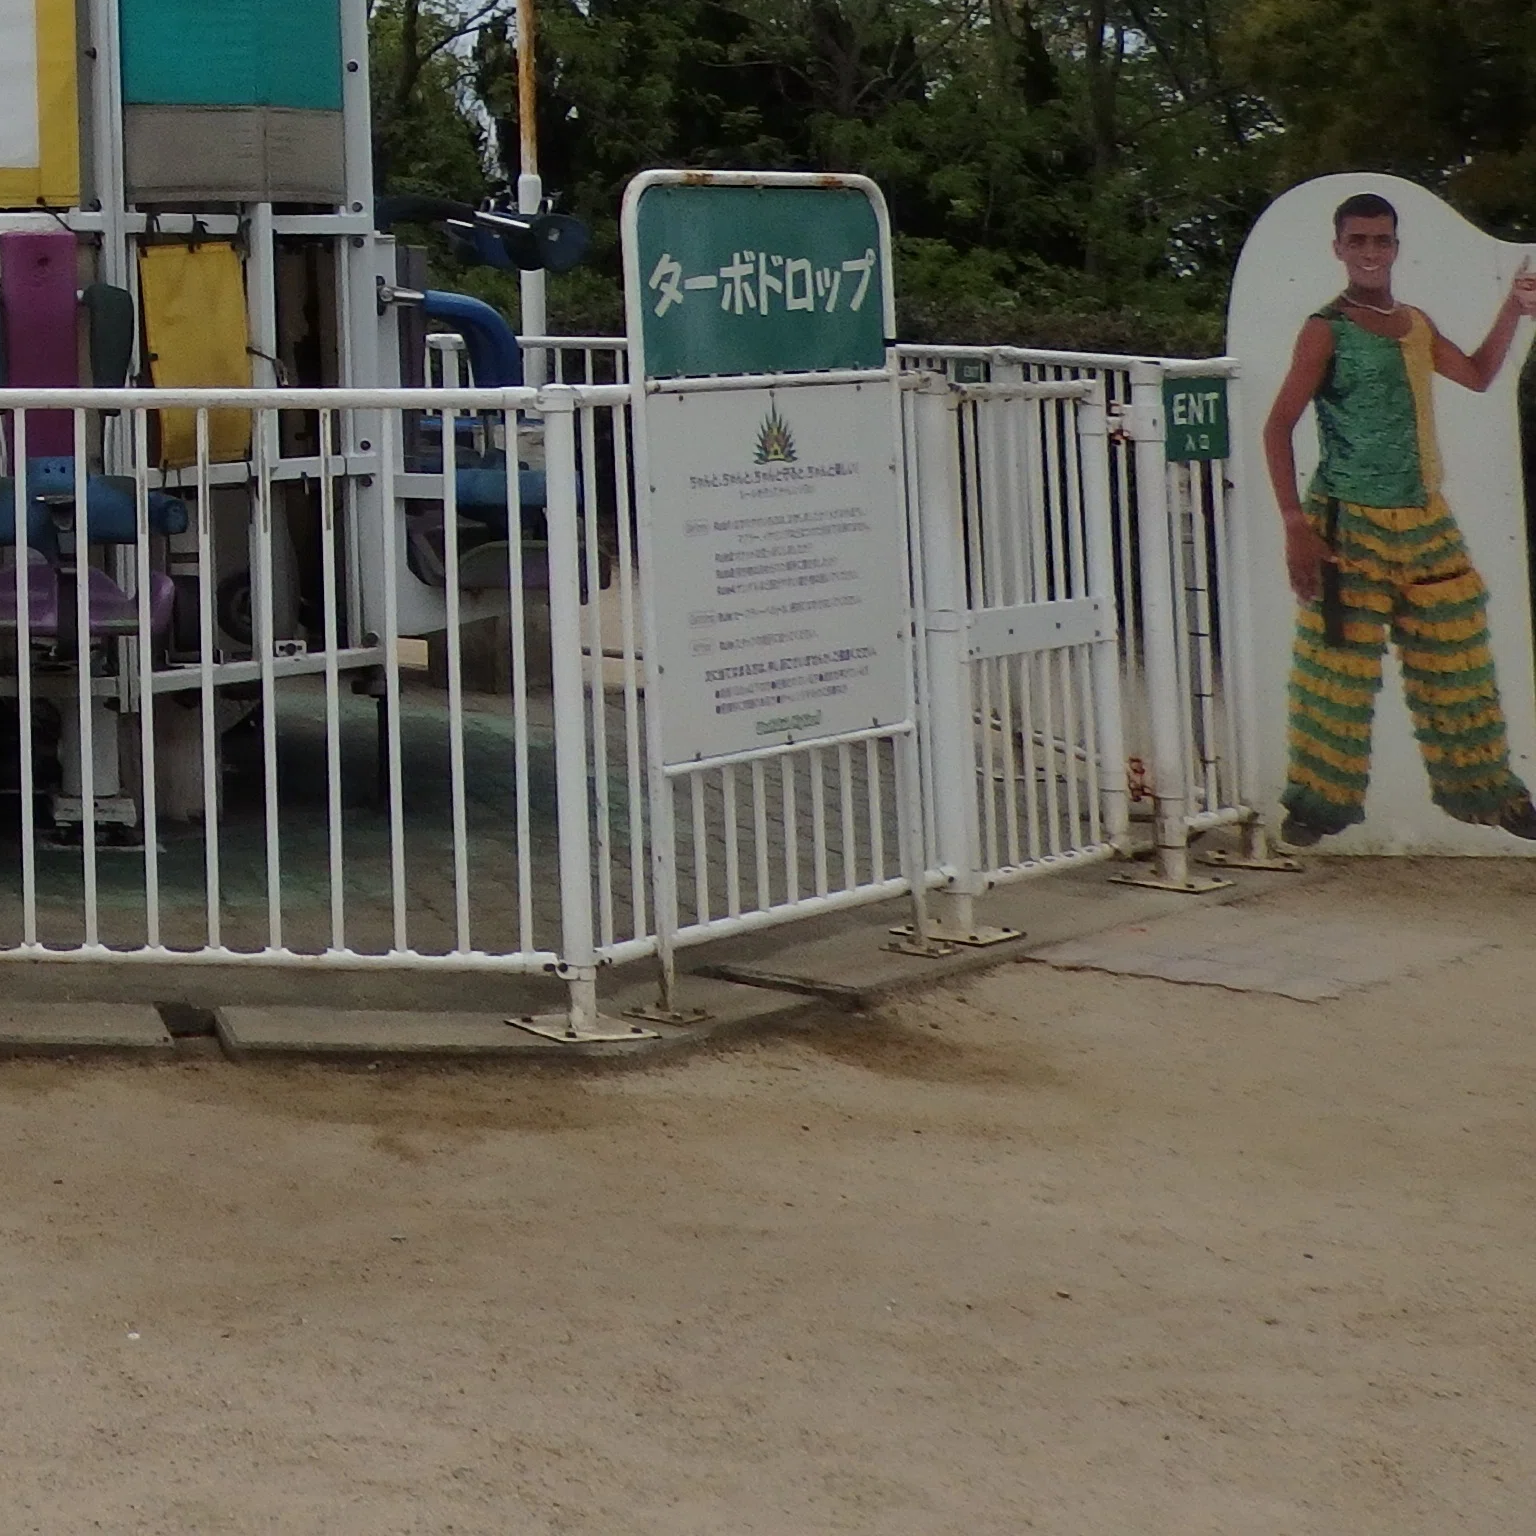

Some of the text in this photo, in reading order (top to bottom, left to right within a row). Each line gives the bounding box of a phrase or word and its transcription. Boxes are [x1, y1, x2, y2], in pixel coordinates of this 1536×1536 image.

[648, 248, 877, 318] ターボドロップ
[1173, 392, 1220, 426] ENT
